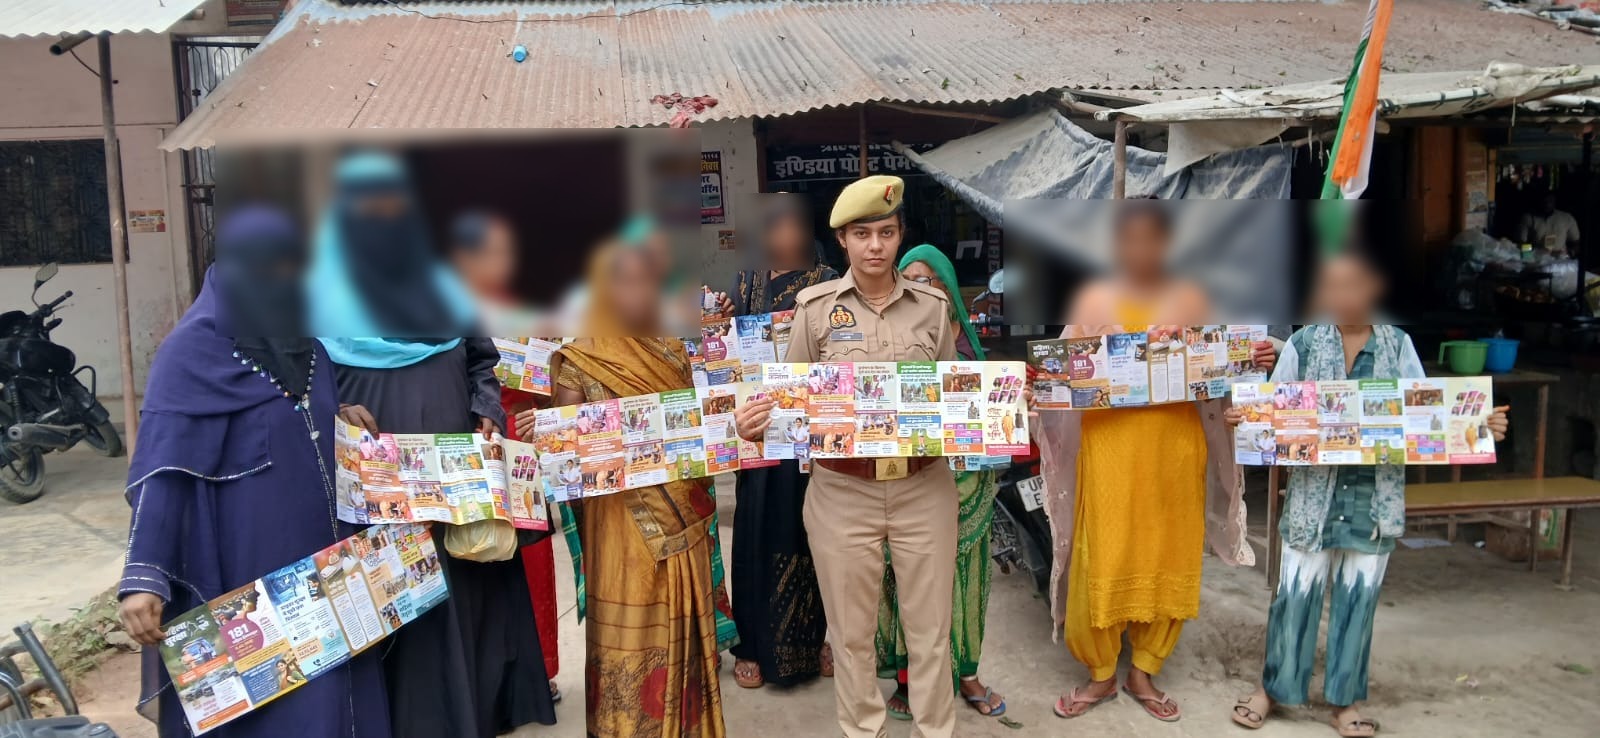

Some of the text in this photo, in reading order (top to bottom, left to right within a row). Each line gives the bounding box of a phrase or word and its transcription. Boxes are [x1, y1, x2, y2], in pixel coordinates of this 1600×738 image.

[773, 155, 837, 178] इण्डिया
[839, 153, 880, 173] पोट
[228, 623, 249, 640] 181
